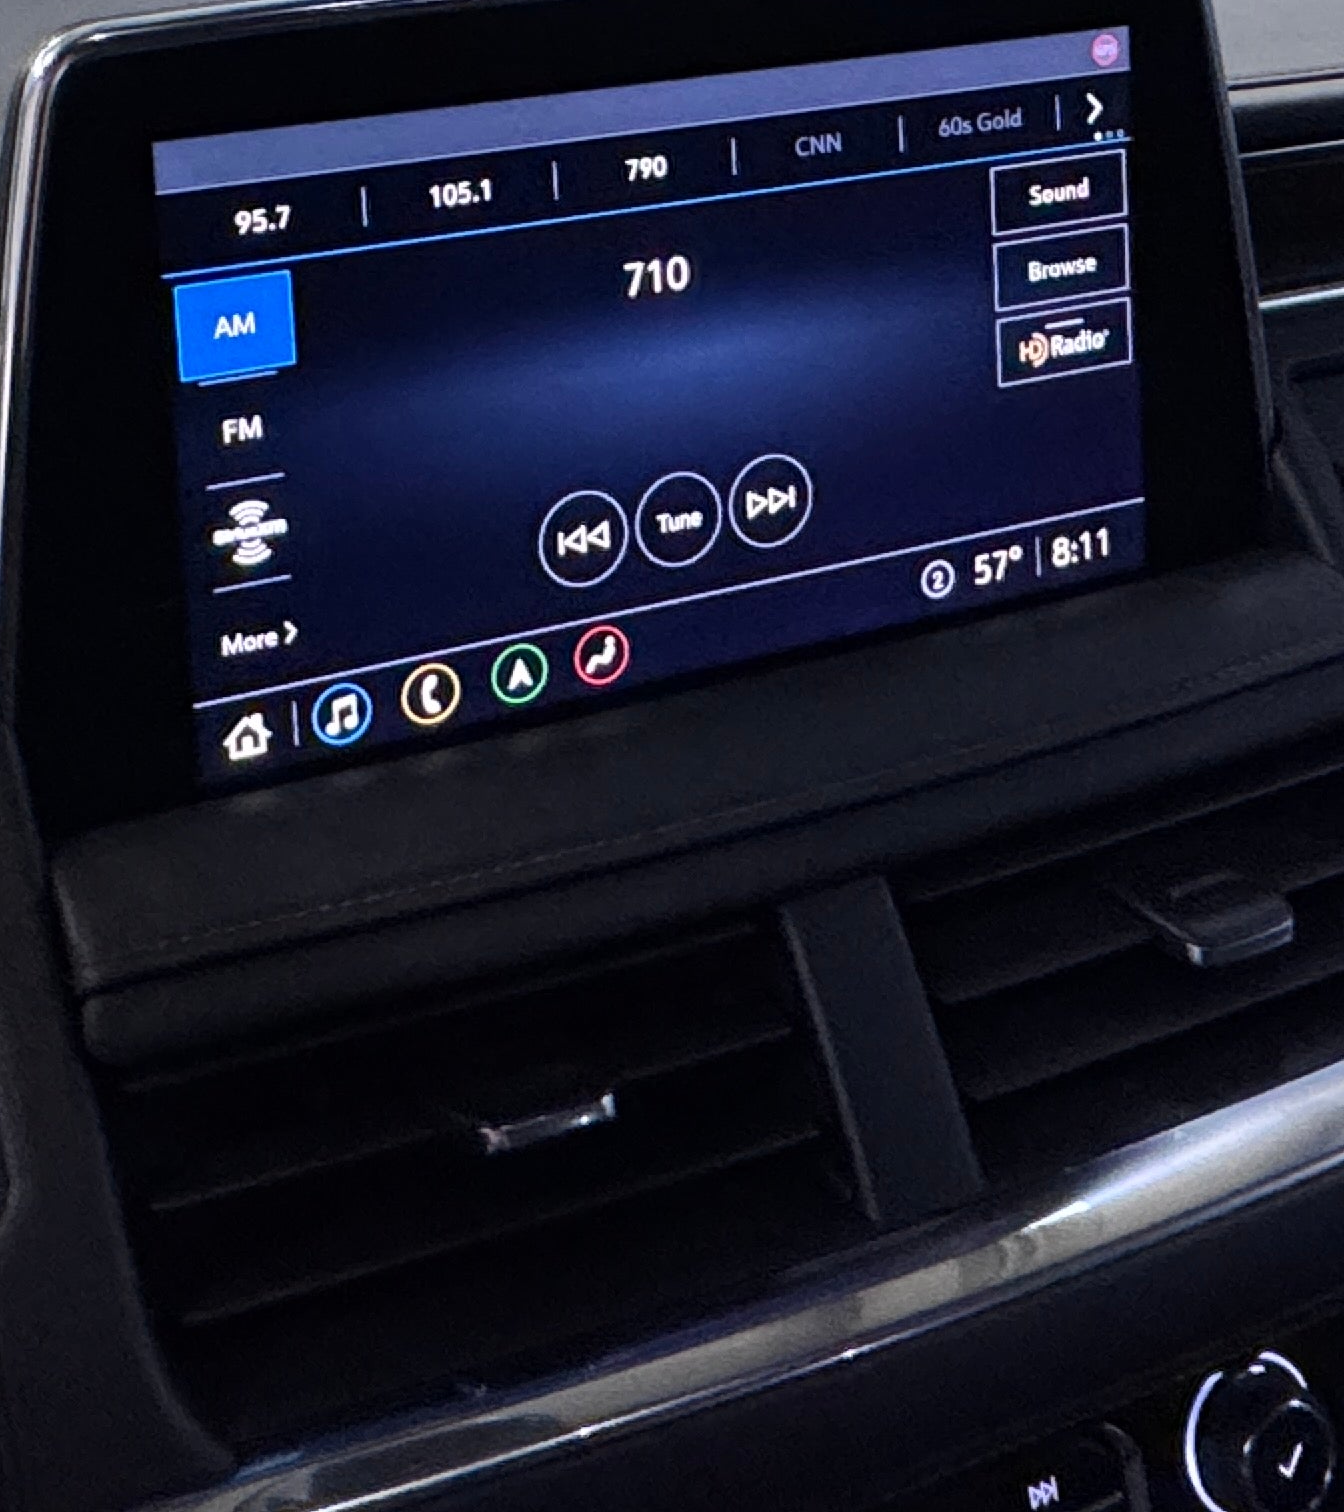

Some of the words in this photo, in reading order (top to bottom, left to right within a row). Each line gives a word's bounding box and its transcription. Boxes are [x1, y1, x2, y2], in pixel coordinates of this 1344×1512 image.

[938, 114, 972, 139] 60s
[975, 106, 1024, 133] Gold
[794, 132, 843, 158] CNN
[624, 154, 669, 182] 790
[428, 178, 493, 208] 105.1
[1028, 176, 1090, 206] Sound
[234, 204, 292, 236] 95.7
[622, 255, 691, 298] 710
[1027, 256, 1098, 283] Browse
[214, 311, 256, 340] AM
[222, 414, 264, 444] FM
[655, 510, 704, 535] Tune
[1051, 526, 1109, 568] 8:11
[931, 570, 946, 590] 2
[220, 630, 280, 657] More
